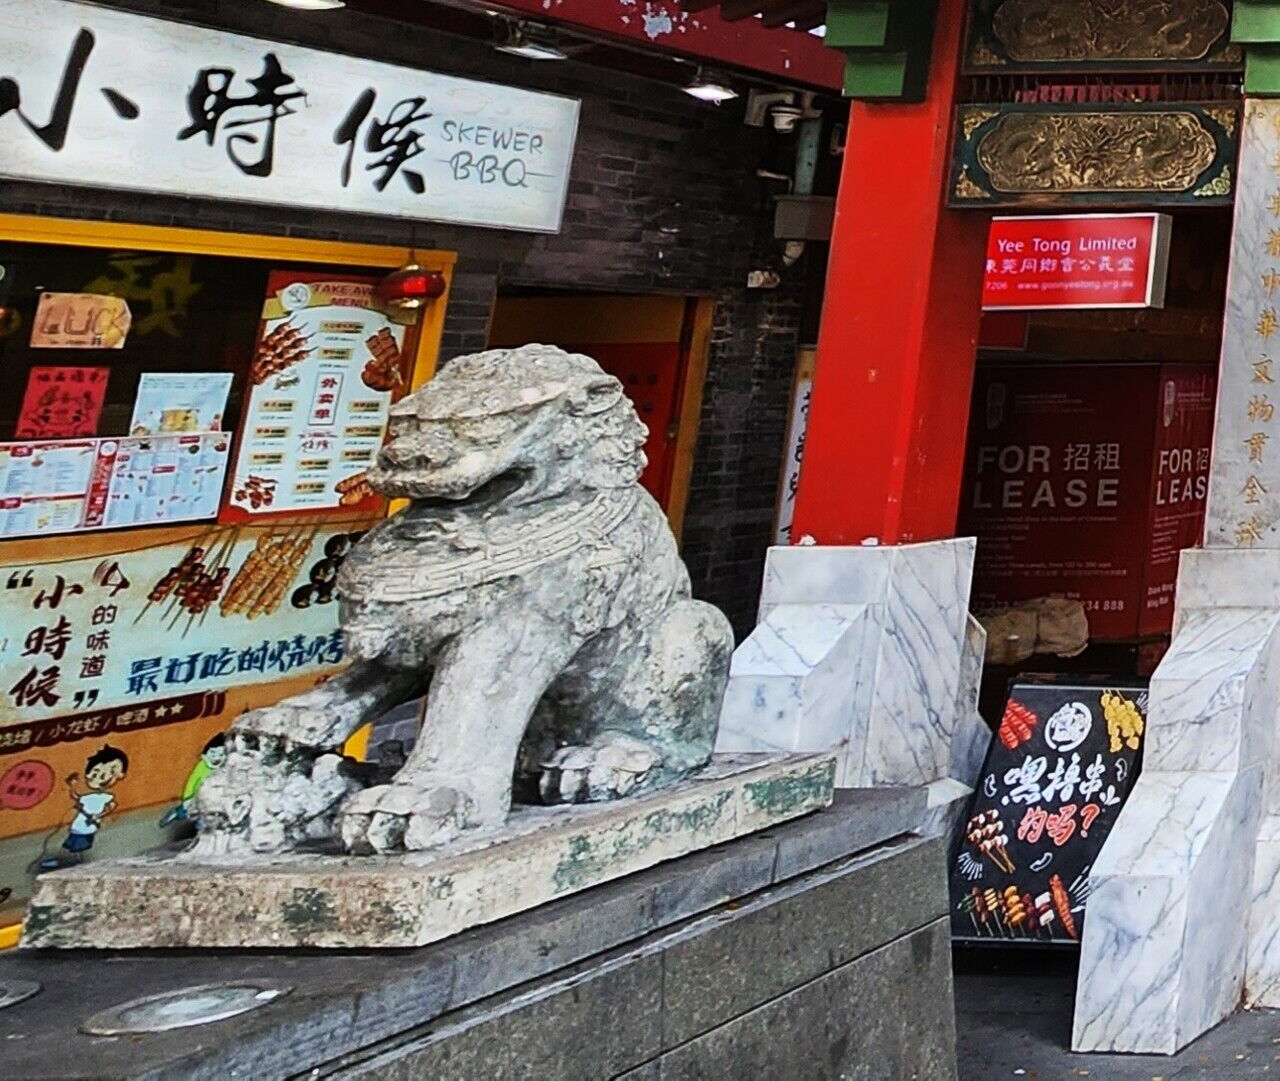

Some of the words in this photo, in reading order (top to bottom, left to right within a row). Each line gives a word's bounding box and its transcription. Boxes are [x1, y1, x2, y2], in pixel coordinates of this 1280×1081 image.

[0, 26, 433, 195] 小時候
[440, 120, 544, 156] SKEWER
[450, 150, 529, 189] BBQ
[998, 239, 1024, 253] Yee
[1033, 237, 1071, 255] Tong
[1079, 236, 1137, 252] Limited
[313, 283, 347, 296] TAKE
[977, 445, 1051, 474] FOR
[1064, 443, 1121, 471] 招租
[1158, 448, 1192, 475] FOR
[972, 478, 1119, 509] LEASE
[1156, 475, 1206, 506] LEAS
